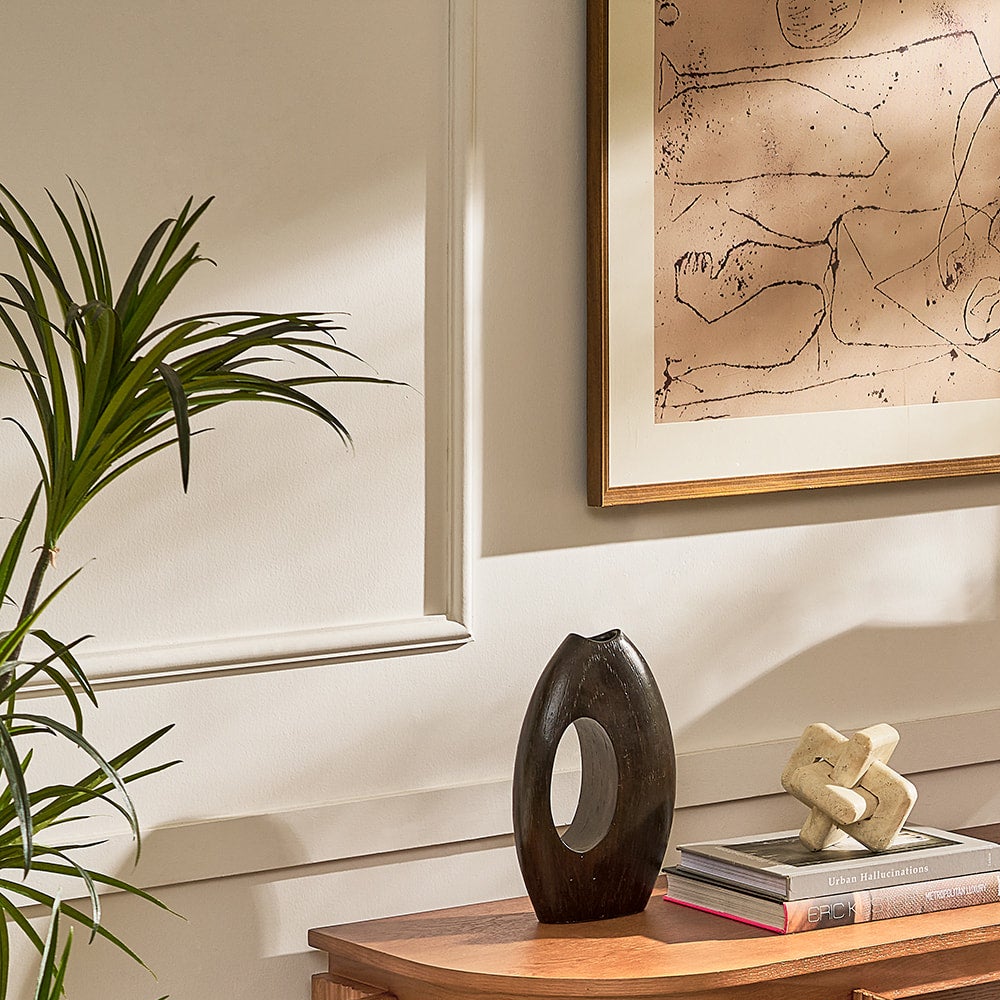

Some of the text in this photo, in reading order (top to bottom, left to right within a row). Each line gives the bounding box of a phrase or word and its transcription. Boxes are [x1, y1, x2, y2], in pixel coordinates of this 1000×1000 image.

[827, 864, 929, 887] Urban Hallucinations
[807, 902, 845, 923] ERIC
